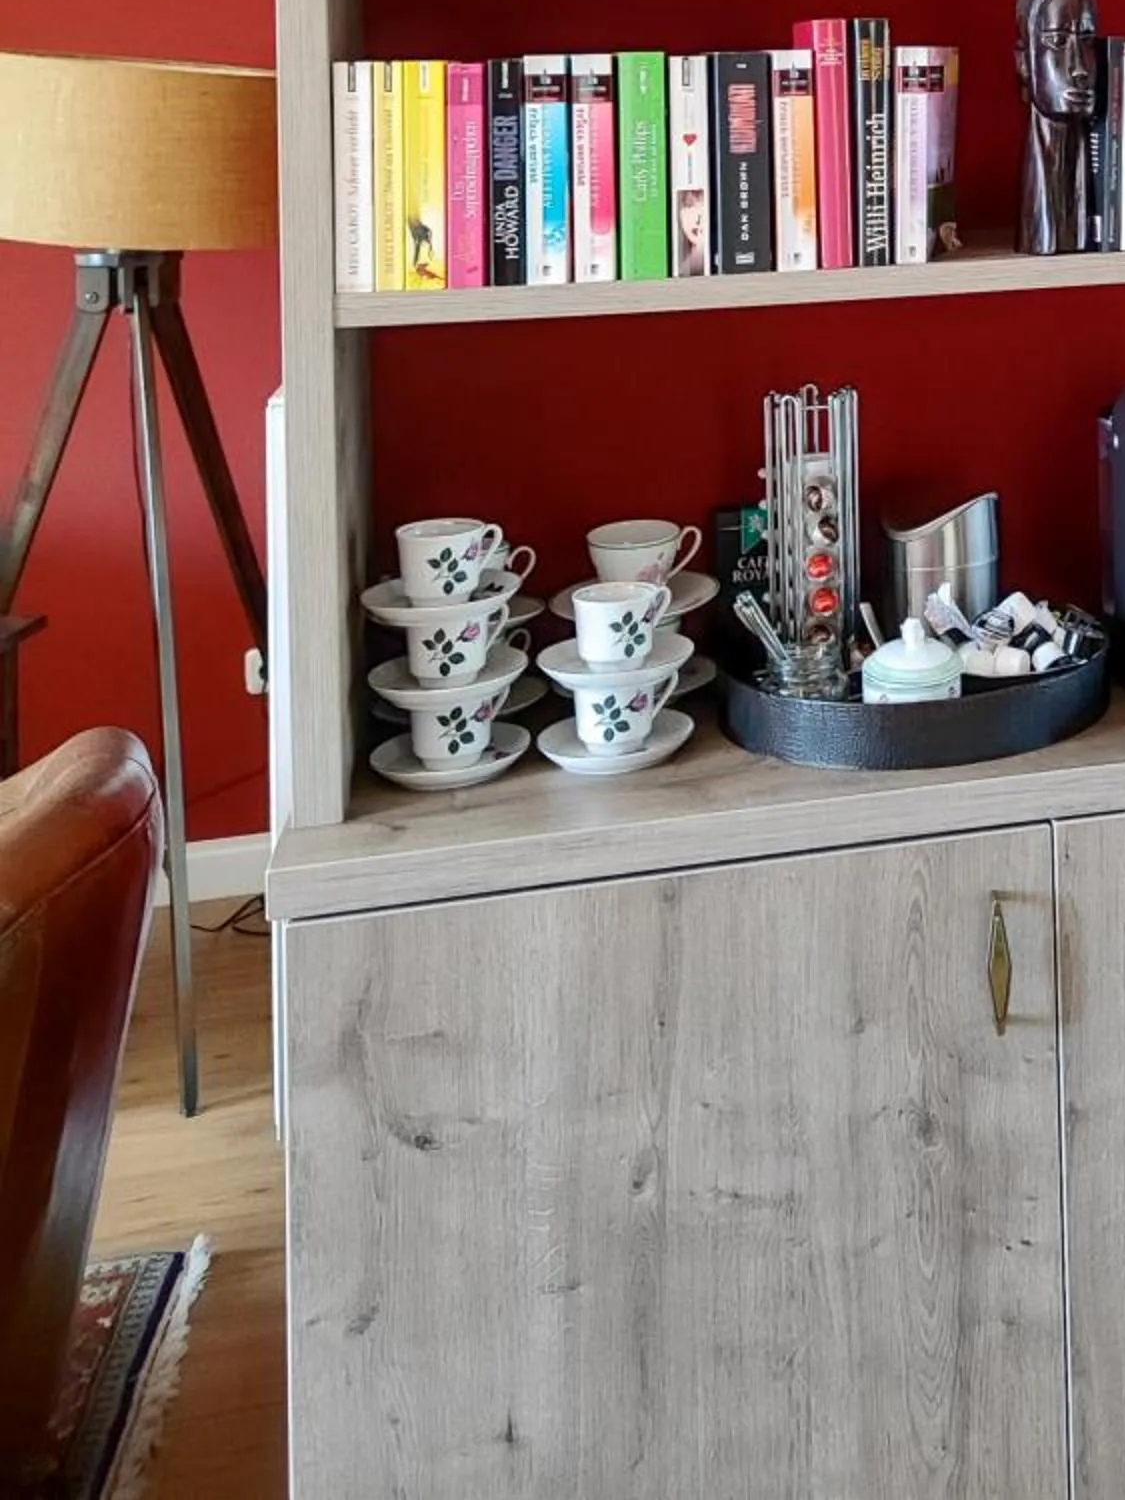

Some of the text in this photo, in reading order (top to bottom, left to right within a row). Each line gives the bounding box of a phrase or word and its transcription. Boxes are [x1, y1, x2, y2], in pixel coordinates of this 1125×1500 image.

[493, 115, 518, 181] DANGER
[739, 161, 749, 209] BROWN
[864, 112, 887, 253] Willi Heinrich
[495, 203, 507, 244] LINDA
[505, 185, 519, 260] HOWARD
[740, 214, 750, 241] DAN
